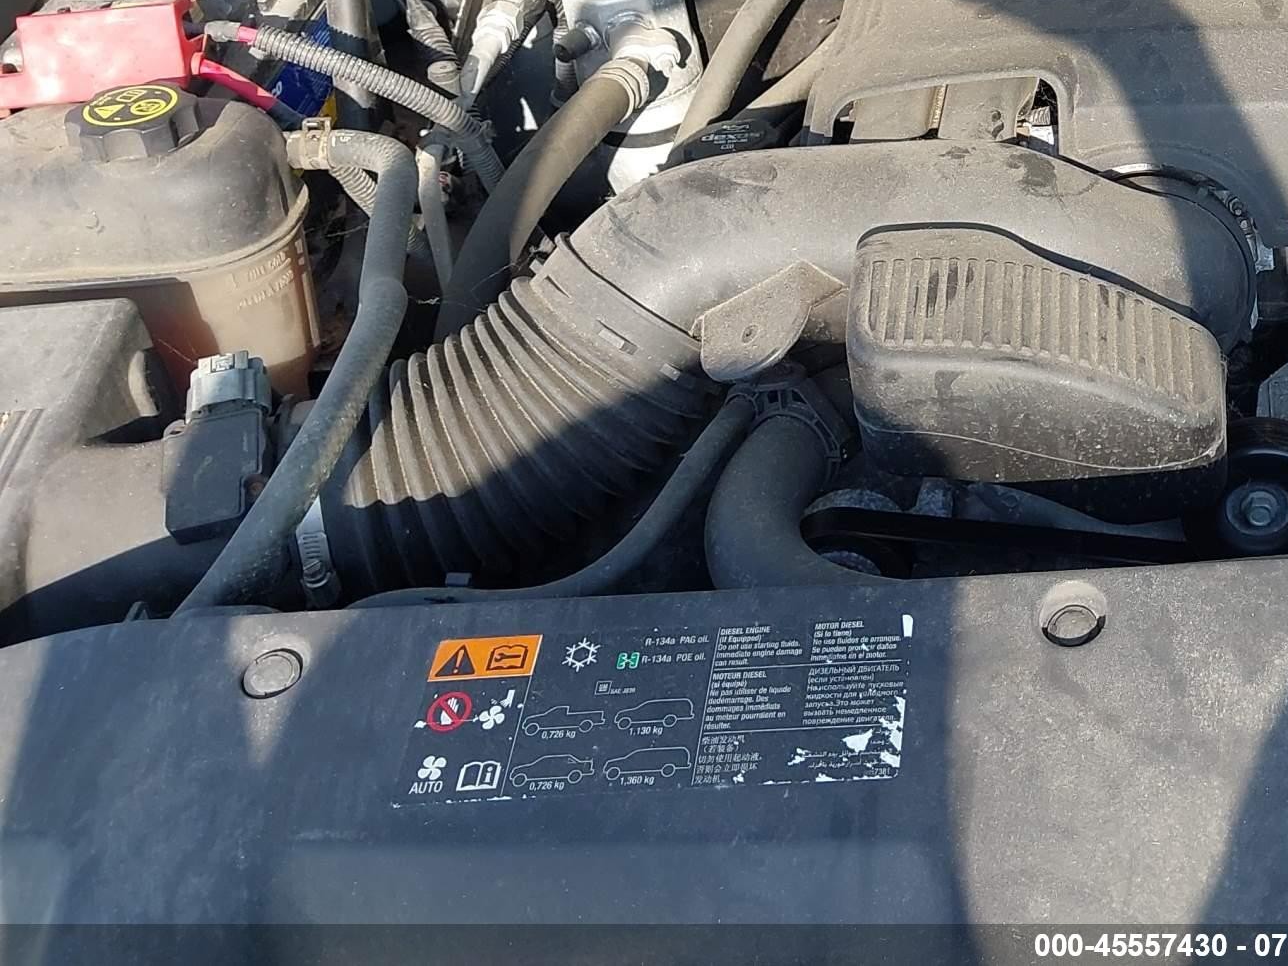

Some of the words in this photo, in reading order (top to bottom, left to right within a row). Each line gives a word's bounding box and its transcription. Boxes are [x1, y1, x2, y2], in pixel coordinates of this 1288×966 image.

[720, 627, 744, 635] DIESEL
[745, 625, 771, 634] ENGINE
[814, 622, 839, 630] MOTOR
[840, 620, 864, 629] DIESEL
[645, 636, 675, 646] R-134a
[679, 635, 696, 644] PAG
[752, 649, 774, 657] engine
[641, 655, 672, 664] R-134a
[676, 653, 693, 662] POE
[694, 653, 706, 661] oil.
[712, 672, 741, 680] MOTEUR
[743, 670, 767, 679] DIESEL
[720, 689, 733, 697] pas
[758, 686, 768, 694] de
[755, 694, 769, 703] Des
[542, 730, 564, 739] 0,726
[565, 730, 576, 739] kg
[652, 726, 663, 735] kg
[620, 776, 642, 785] 1,360
[643, 776, 655, 785] kg
[408, 781, 443, 794] AUTO
[529, 782, 552, 791] 0,726
[554, 781, 565, 791] kg
